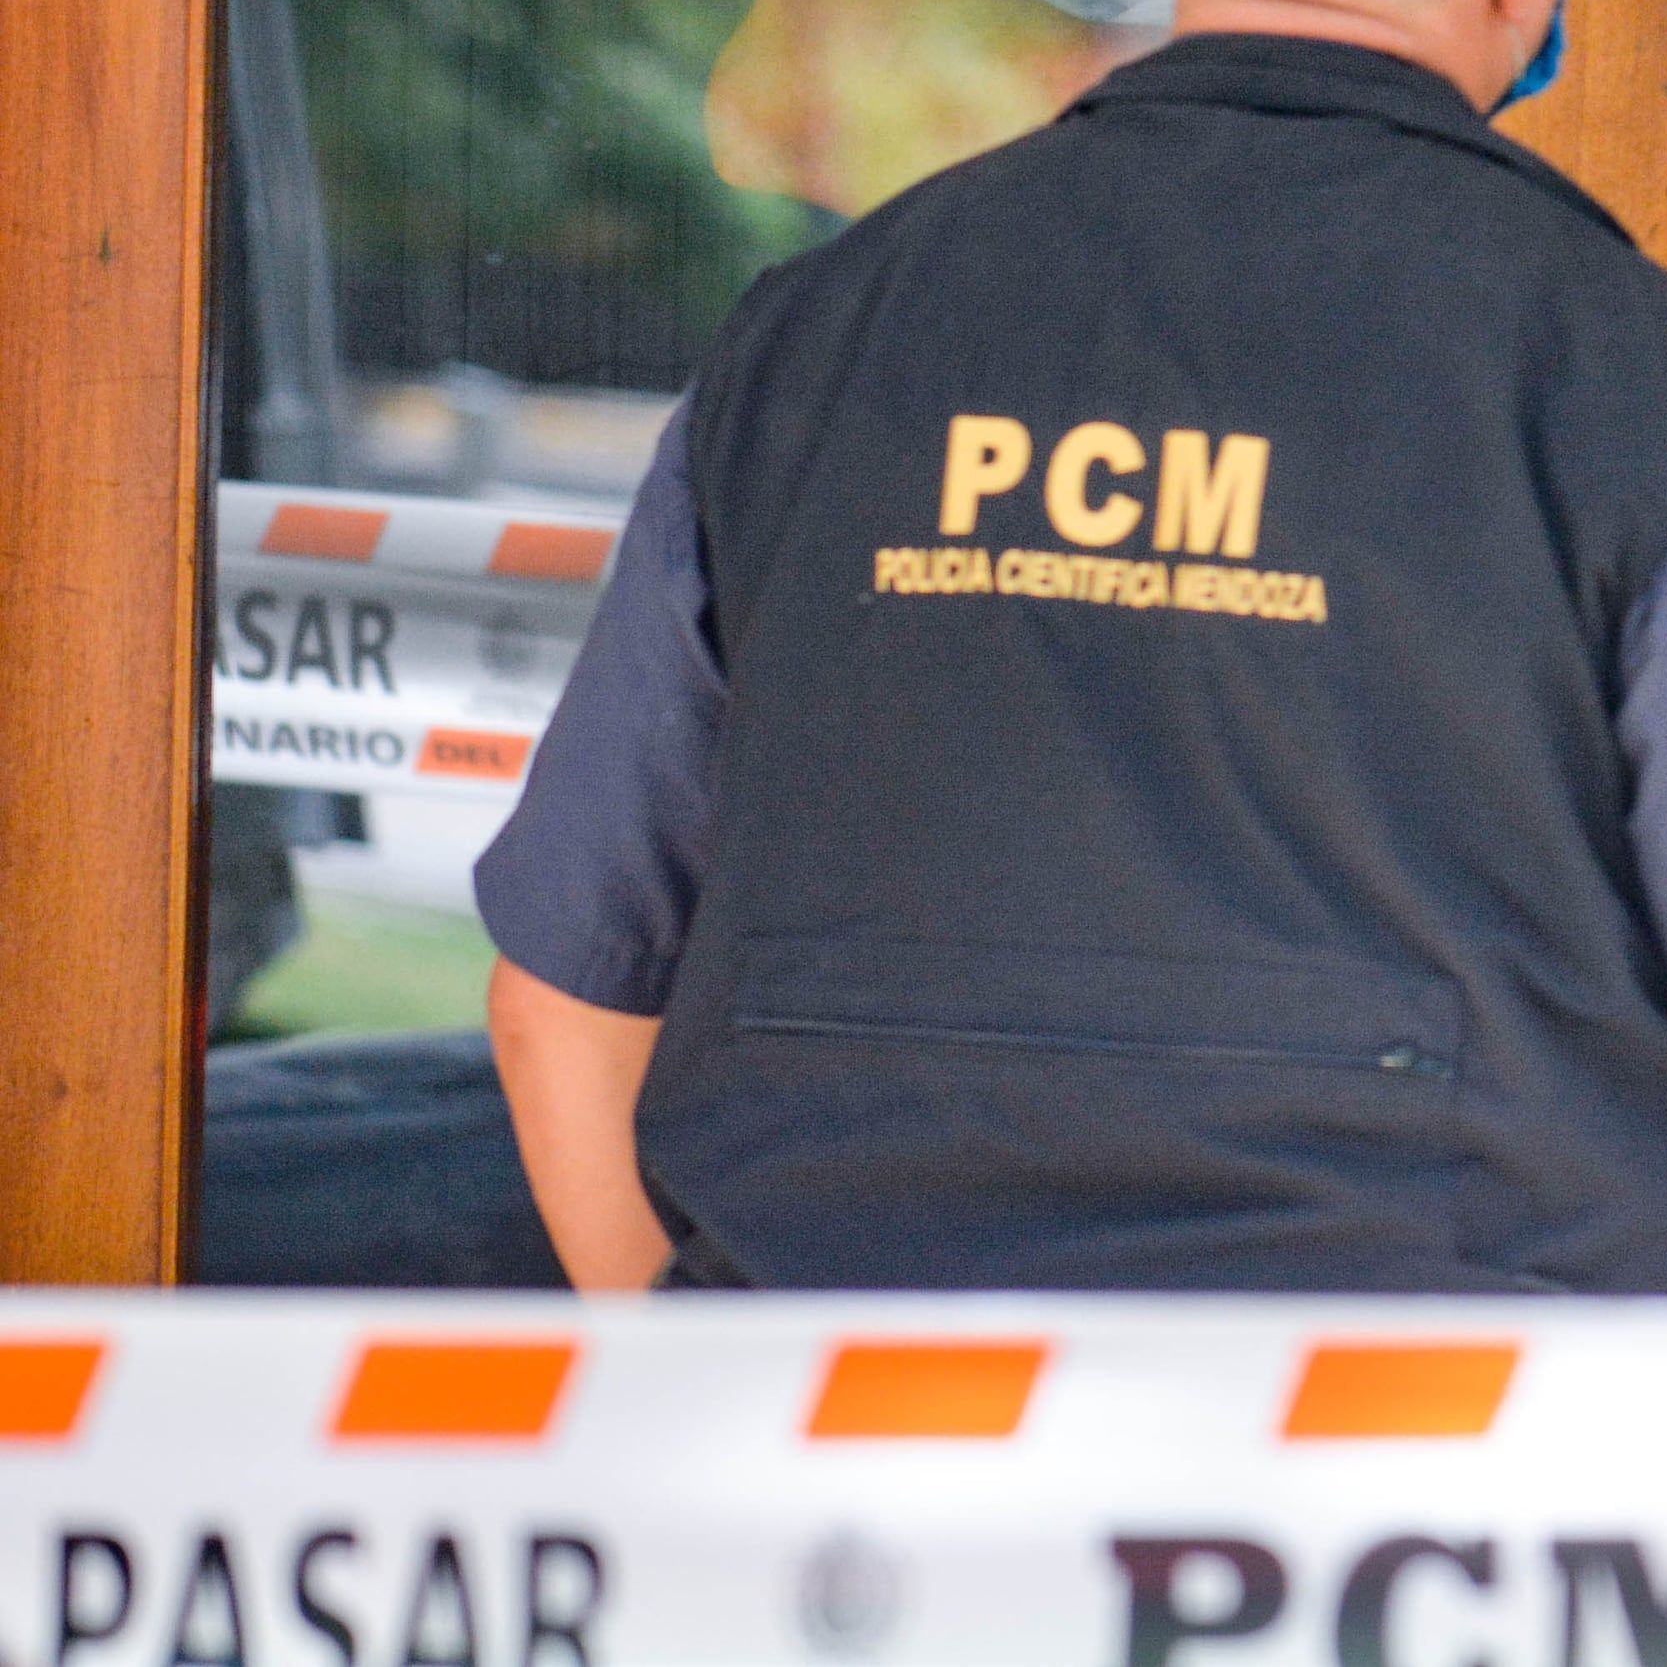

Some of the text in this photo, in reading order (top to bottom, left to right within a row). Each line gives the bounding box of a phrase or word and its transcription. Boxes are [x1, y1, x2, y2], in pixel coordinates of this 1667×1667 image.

[938, 414, 1271, 559] PCM
[874, 547, 1328, 624] POLICIA CIENTIFICA MENDOZA
[57, 1529, 606, 1667] PASAR
